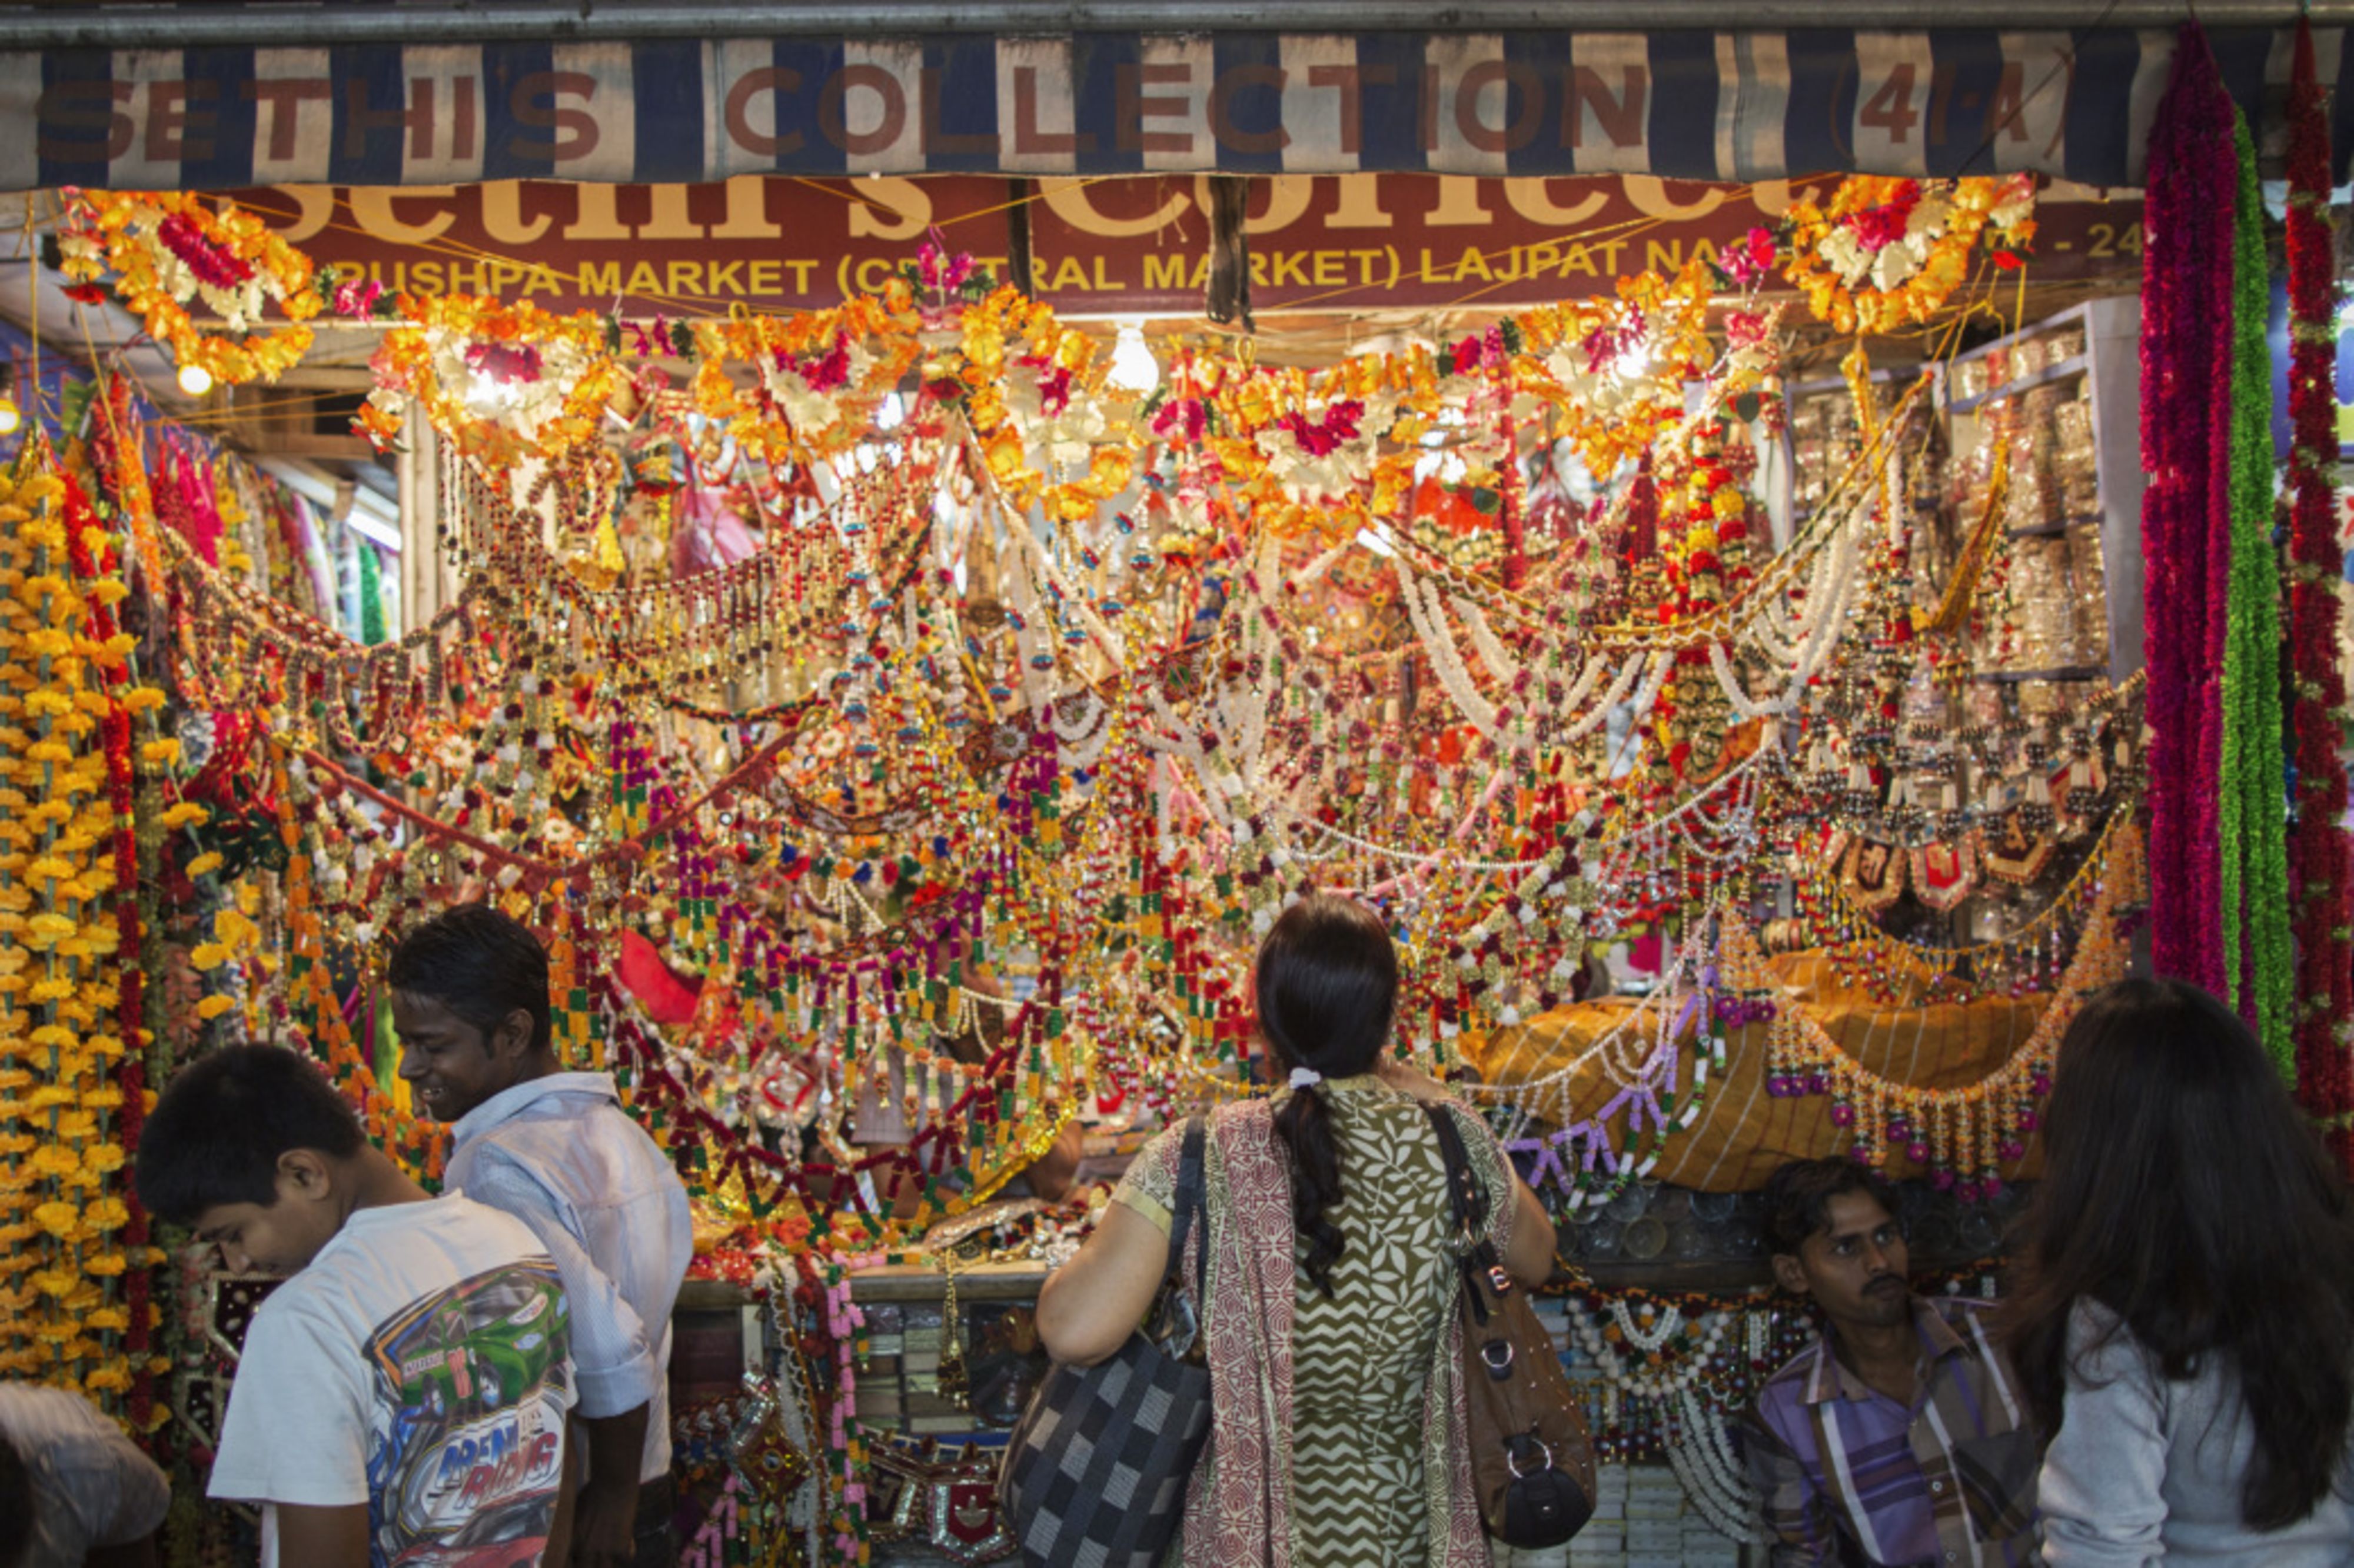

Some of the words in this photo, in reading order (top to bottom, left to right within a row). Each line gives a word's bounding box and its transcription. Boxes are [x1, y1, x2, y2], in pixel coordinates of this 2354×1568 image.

[724, 60, 1646, 157] COLLECTION
[334, 259, 563, 297] PUSHPA
[578, 259, 819, 297] MARKET
[1142, 244, 1401, 289] MARKET)
[1420, 241, 1628, 284] LAJPAT
